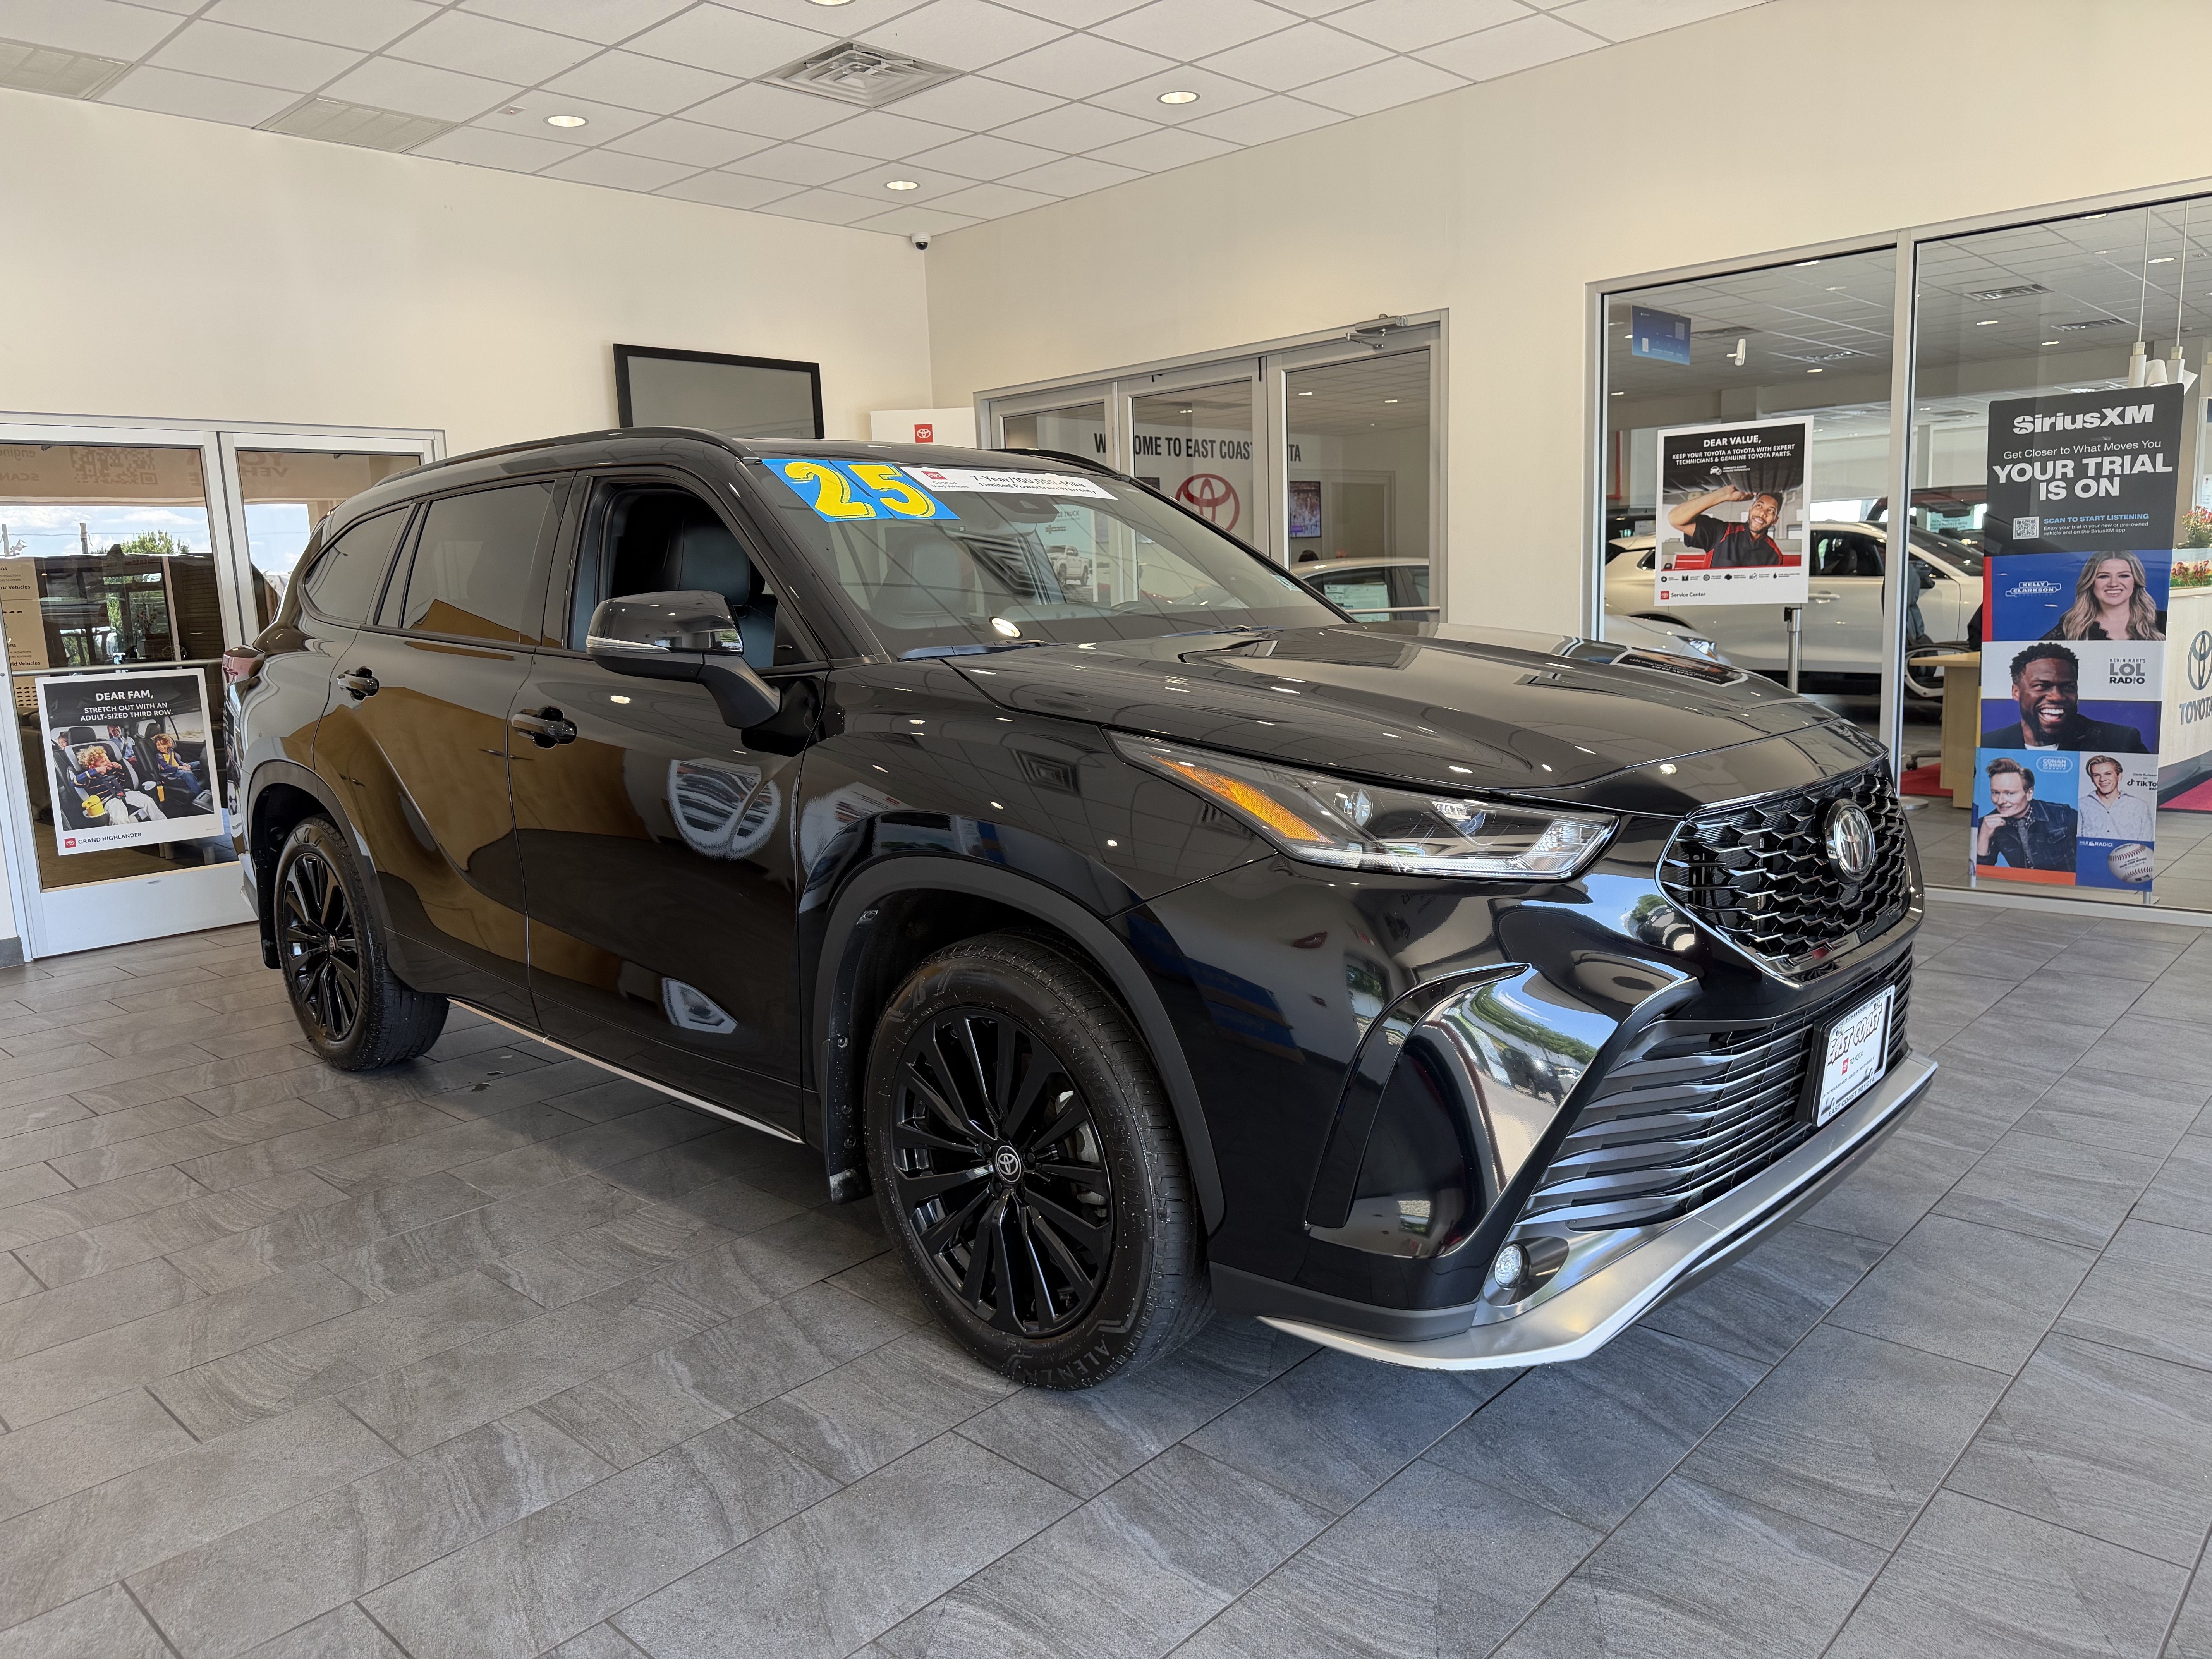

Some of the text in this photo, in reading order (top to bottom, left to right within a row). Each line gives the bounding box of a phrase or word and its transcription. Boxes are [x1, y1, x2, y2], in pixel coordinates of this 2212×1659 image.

[2013, 404, 2154, 434] SiriusXM
[1165, 437, 1182, 457] TO
[1186, 439, 1216, 459] EAST
[1220, 440, 1253, 460] COAS
[1704, 435, 1762, 447] DEAR VALUE,
[2004, 440, 2162, 459] Get Closer to What Moves You
[1992, 453, 2173, 484] YOUR TRIAL
[969, 475, 1086, 488] 7-Year/100,000-Mile
[2039, 477, 2120, 501] IS ON
[2109, 663, 2145, 676] LOL
[96, 690, 154, 701] DEAR FAM,
[80, 712, 129, 721] ADULT-SIZED
[102, 832, 142, 842] HIGHLANDER
[1827, 1005, 1883, 1066] EAST COAST
[1850, 1051, 1863, 1066] TOYOTA
[1828, 1077, 1875, 1117] EAST COAST TOYOTA
[1023, 1338, 1111, 1383] ALENZA
